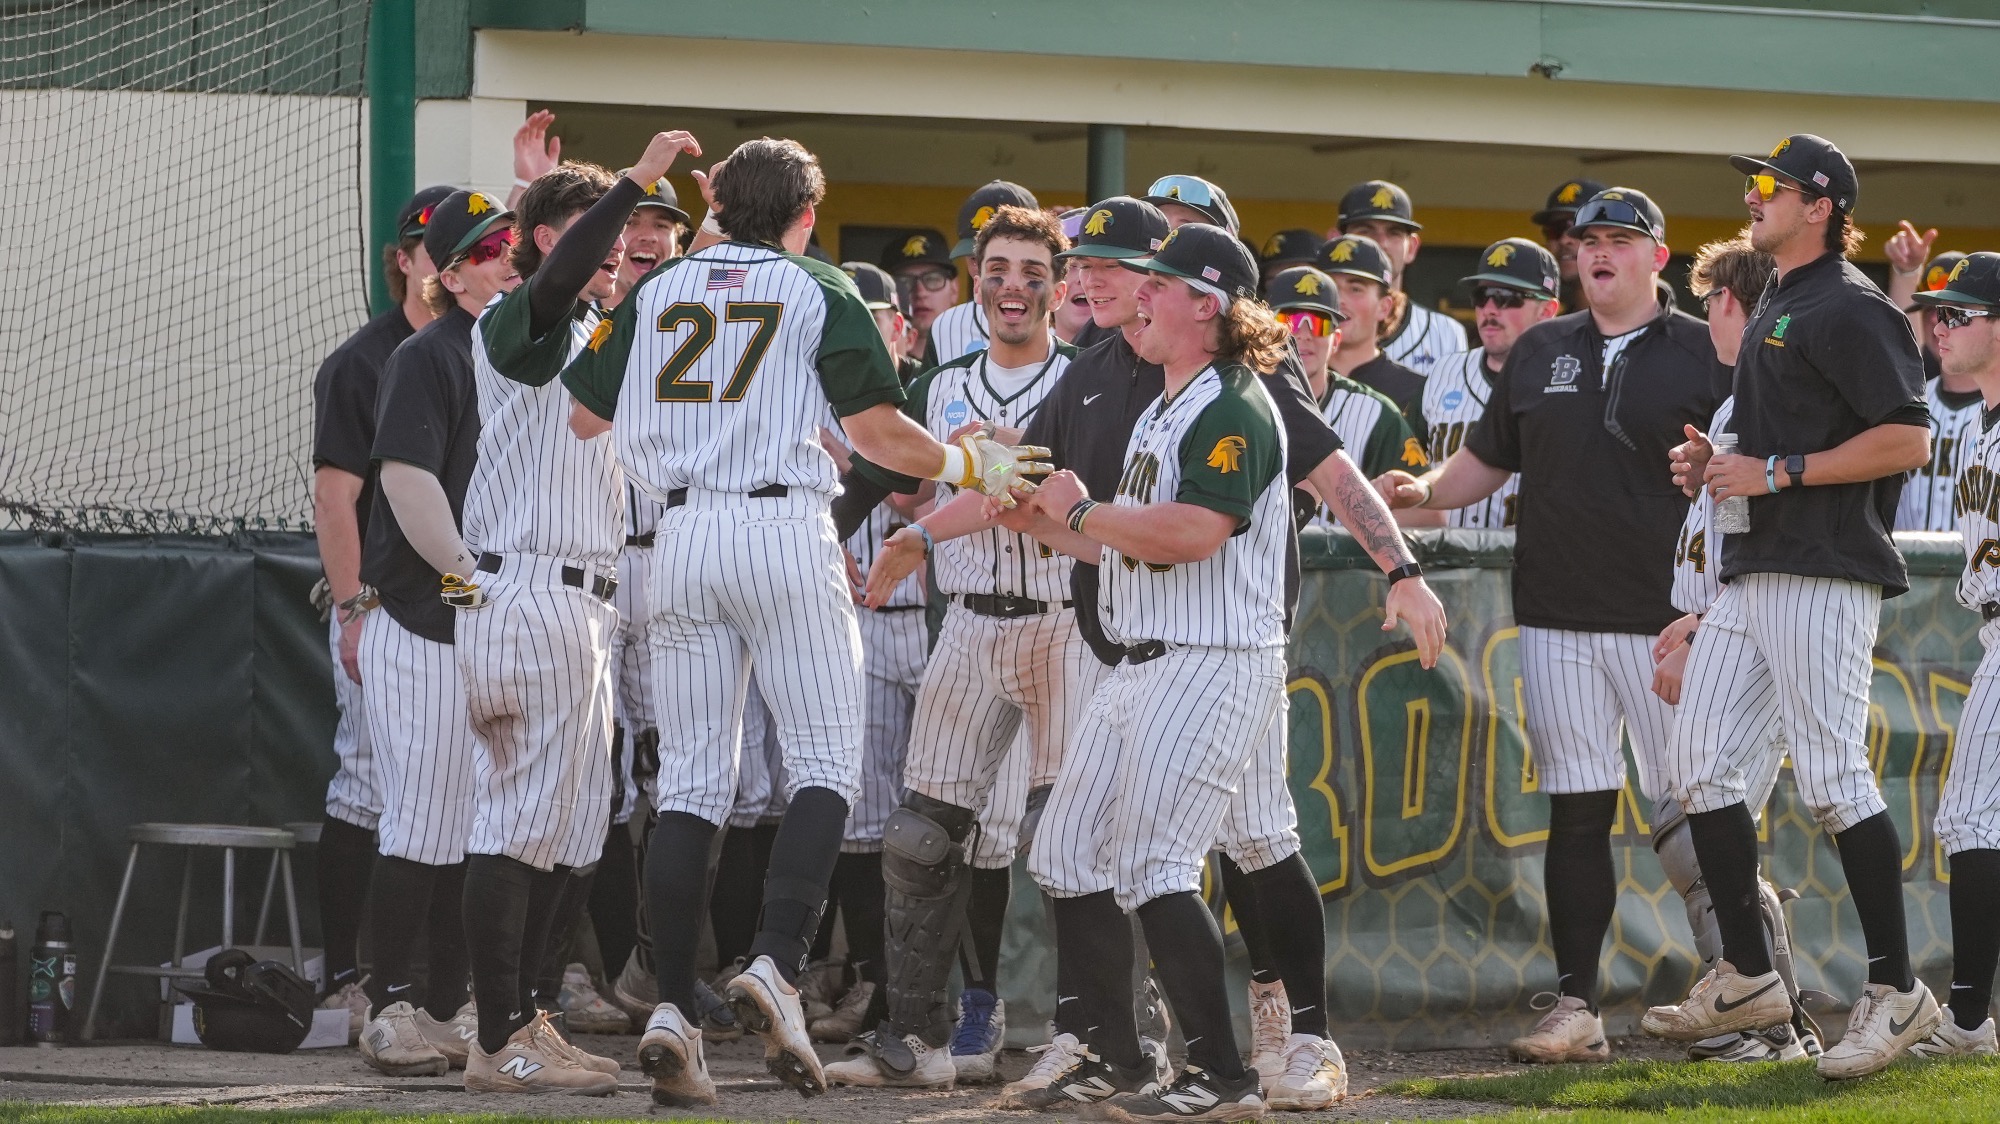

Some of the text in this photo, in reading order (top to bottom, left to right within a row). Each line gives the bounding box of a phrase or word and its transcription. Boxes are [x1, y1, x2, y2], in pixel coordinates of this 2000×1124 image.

[655, 302, 784, 403] 27
[1551, 354, 1581, 385] B
[946, 411, 965, 419] NCAA
[498, 1055, 545, 1081] N
